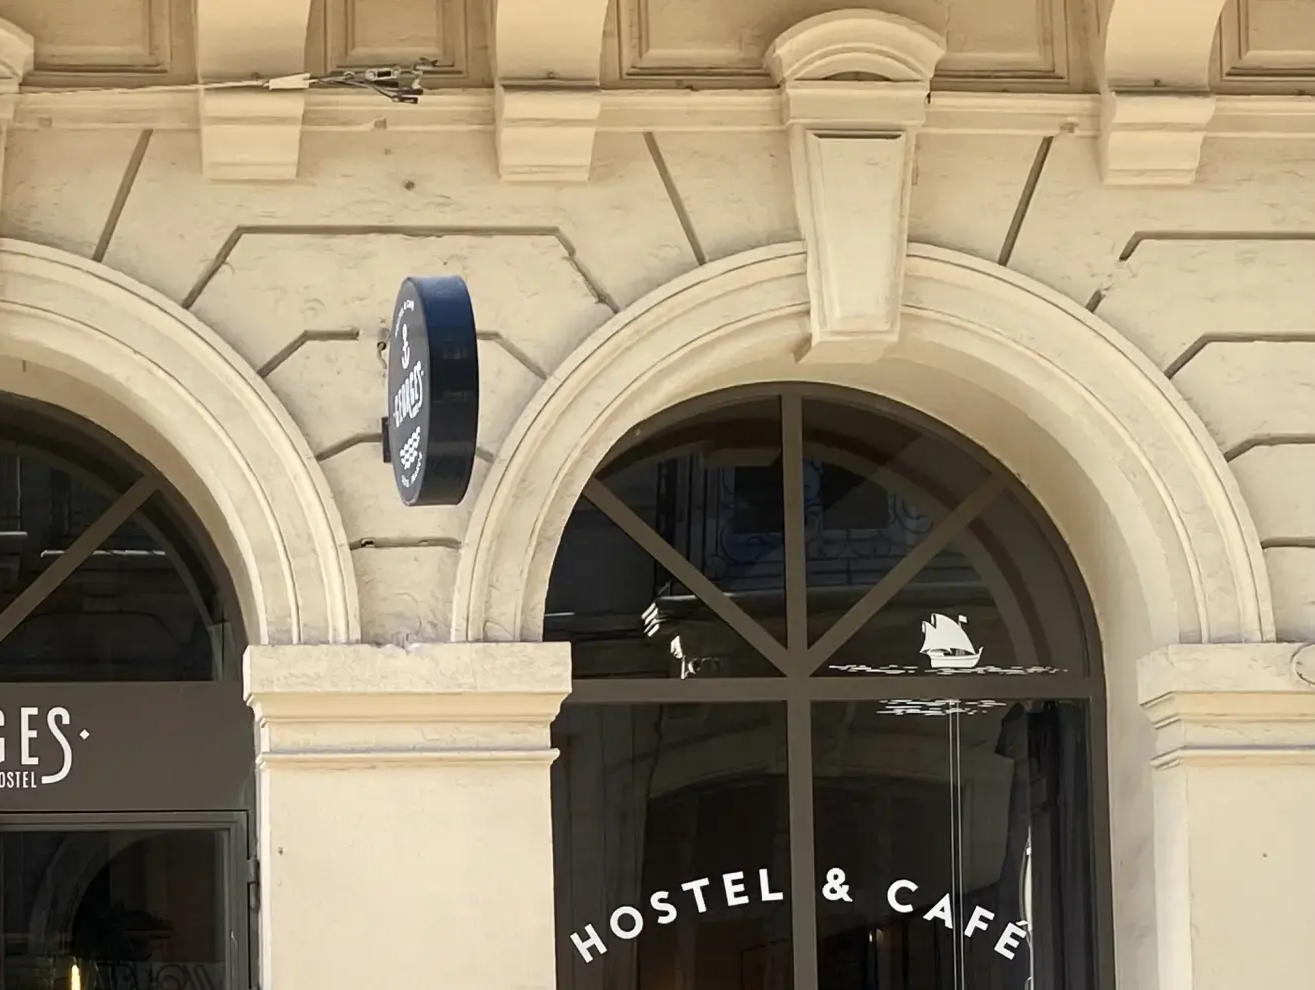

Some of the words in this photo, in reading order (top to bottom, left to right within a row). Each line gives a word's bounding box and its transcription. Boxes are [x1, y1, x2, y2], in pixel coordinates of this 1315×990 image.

[570, 868, 784, 963] HOSTEL
[822, 867, 853, 902] &
[887, 879, 1027, 960] CAFÉ
